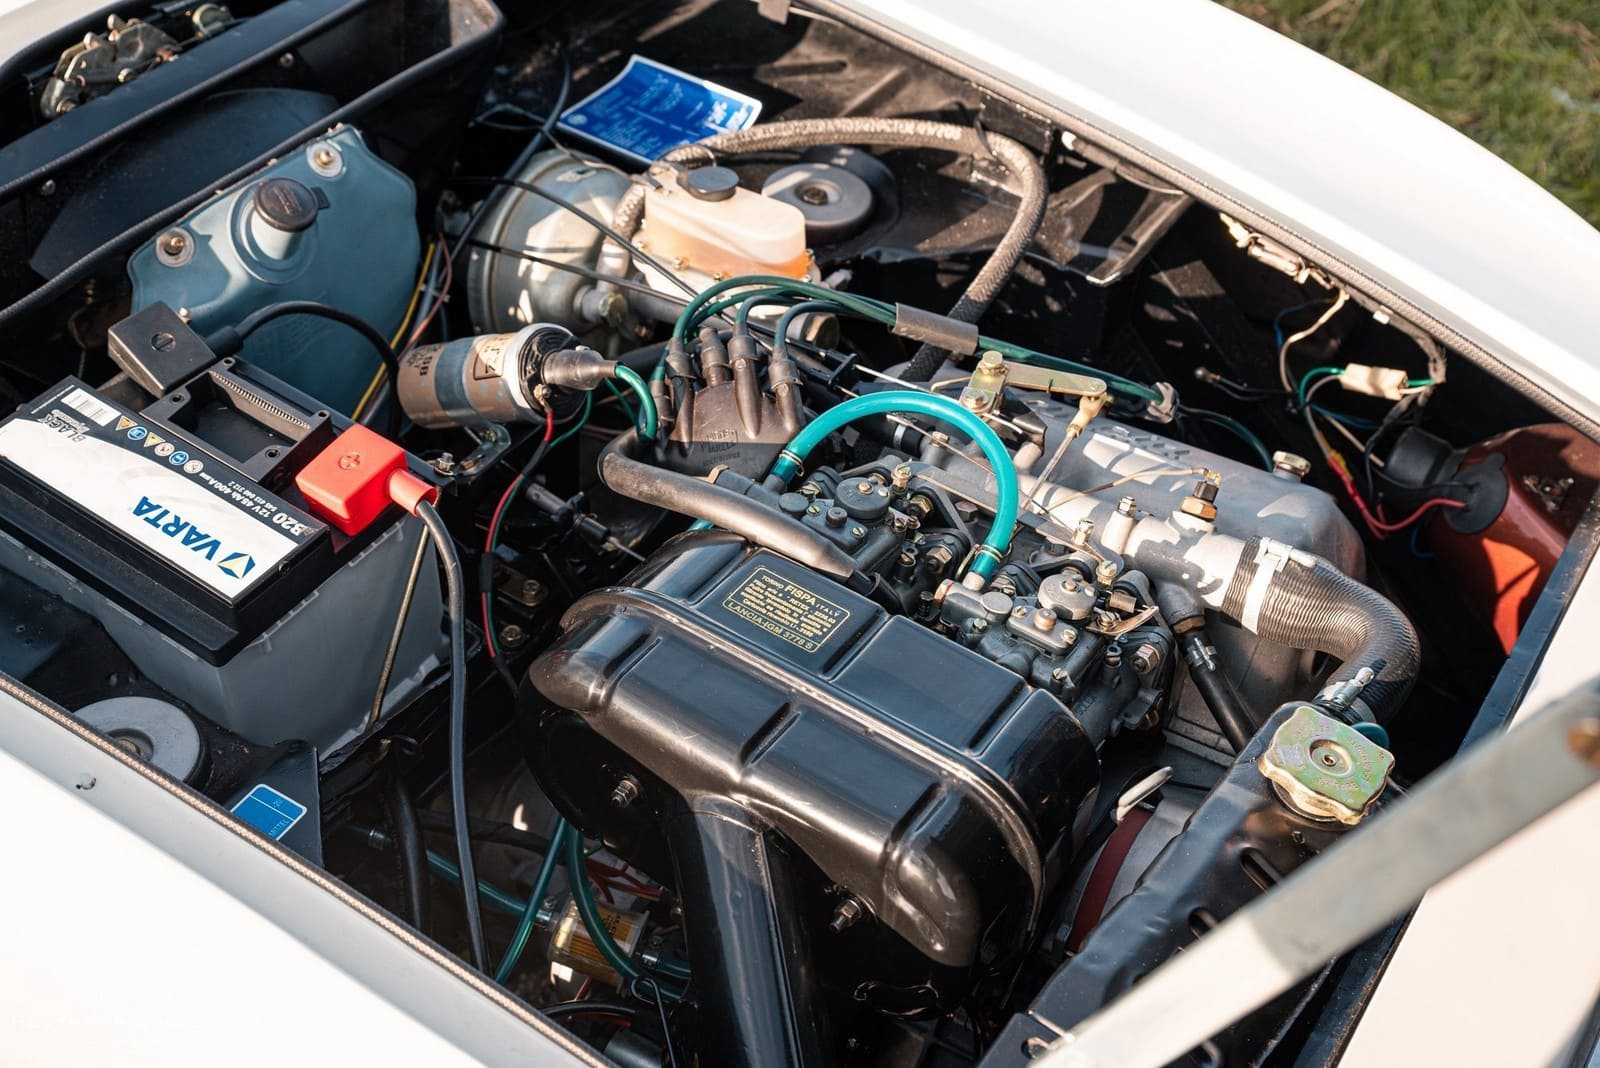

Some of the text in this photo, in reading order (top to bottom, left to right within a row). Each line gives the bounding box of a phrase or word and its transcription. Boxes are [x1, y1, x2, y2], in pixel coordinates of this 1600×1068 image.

[37, 412, 87, 444] BLACK
[230, 490, 254, 507] 45Ah
[252, 503, 270, 517] 12V
[130, 495, 223, 561] VARTA
[272, 511, 304, 536] B20
[784, 584, 817, 605] FISPA
[816, 603, 839, 617] ITALY
[782, 631, 804, 645] 3778
